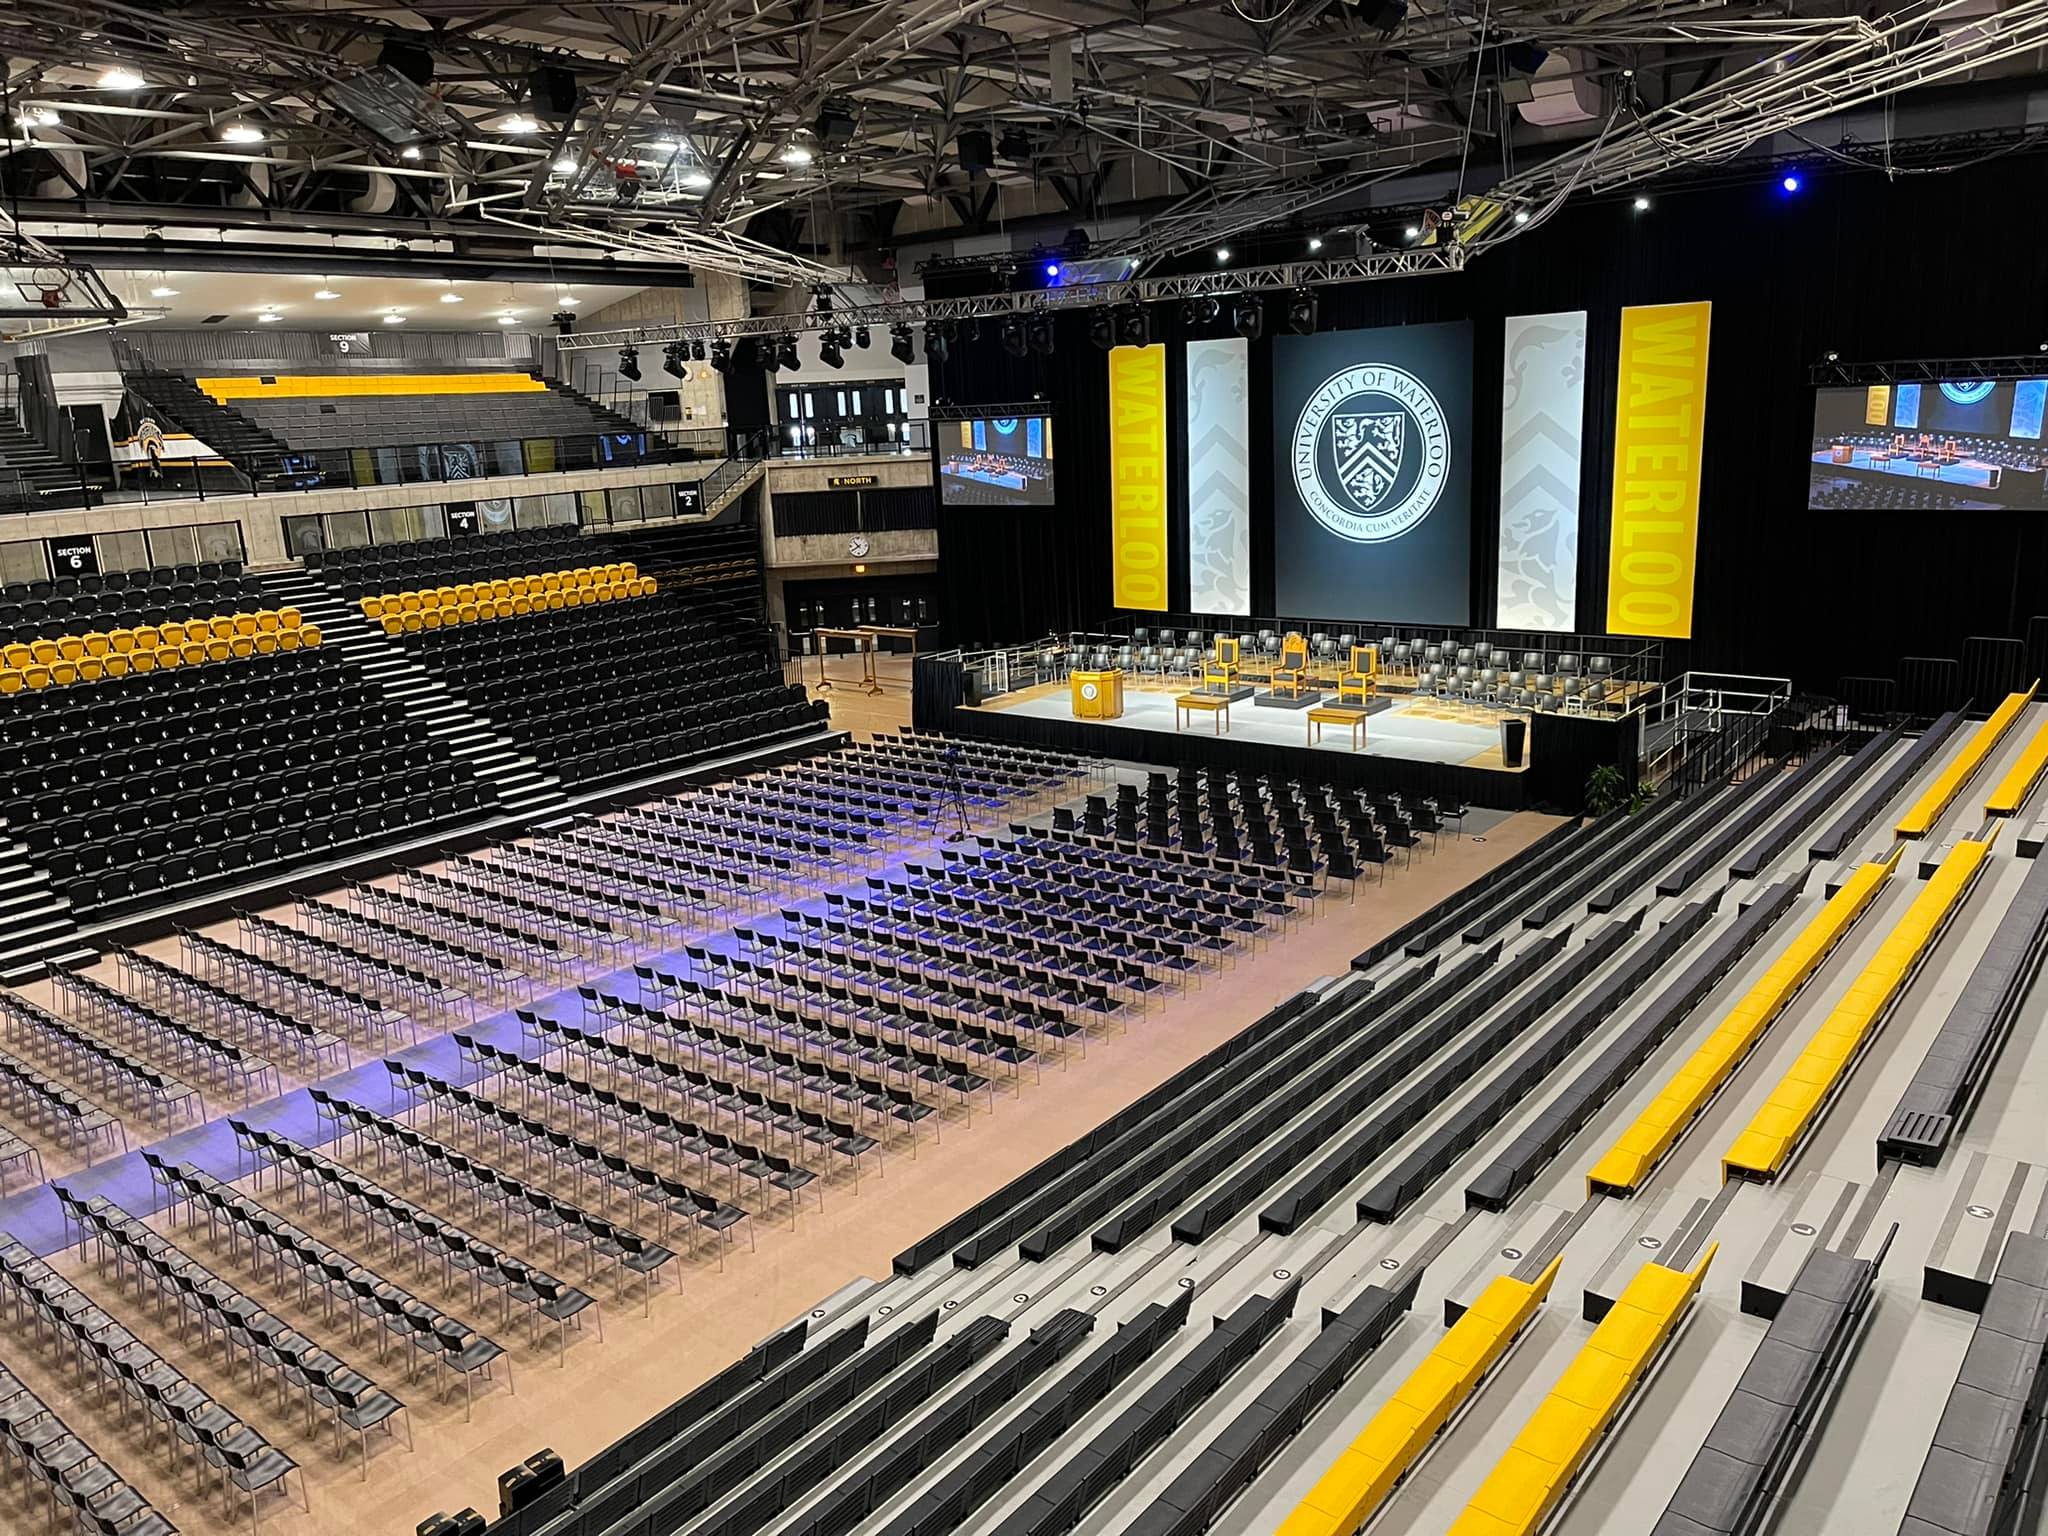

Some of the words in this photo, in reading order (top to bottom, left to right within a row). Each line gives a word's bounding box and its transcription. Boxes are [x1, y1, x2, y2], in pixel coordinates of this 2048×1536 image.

[340, 341, 349, 353] 9
[1299, 374, 1355, 481] UNIVERSITY
[1362, 371, 1387, 387] OF
[1393, 375, 1444, 478] WATERLOO
[1618, 314, 1697, 627] WATERLOO
[844, 477, 872, 485] NORTH
[1116, 353, 1161, 602] WATERLOO
[685, 495, 693, 506] 2
[1310, 490, 1363, 533] CONCORDIA
[1365, 523, 1391, 533] CUM
[1391, 489, 1432, 526] VERITATE
[460, 517, 469, 529] 4
[57, 546, 91, 557] SECTION
[70, 555, 82, 569] 6
